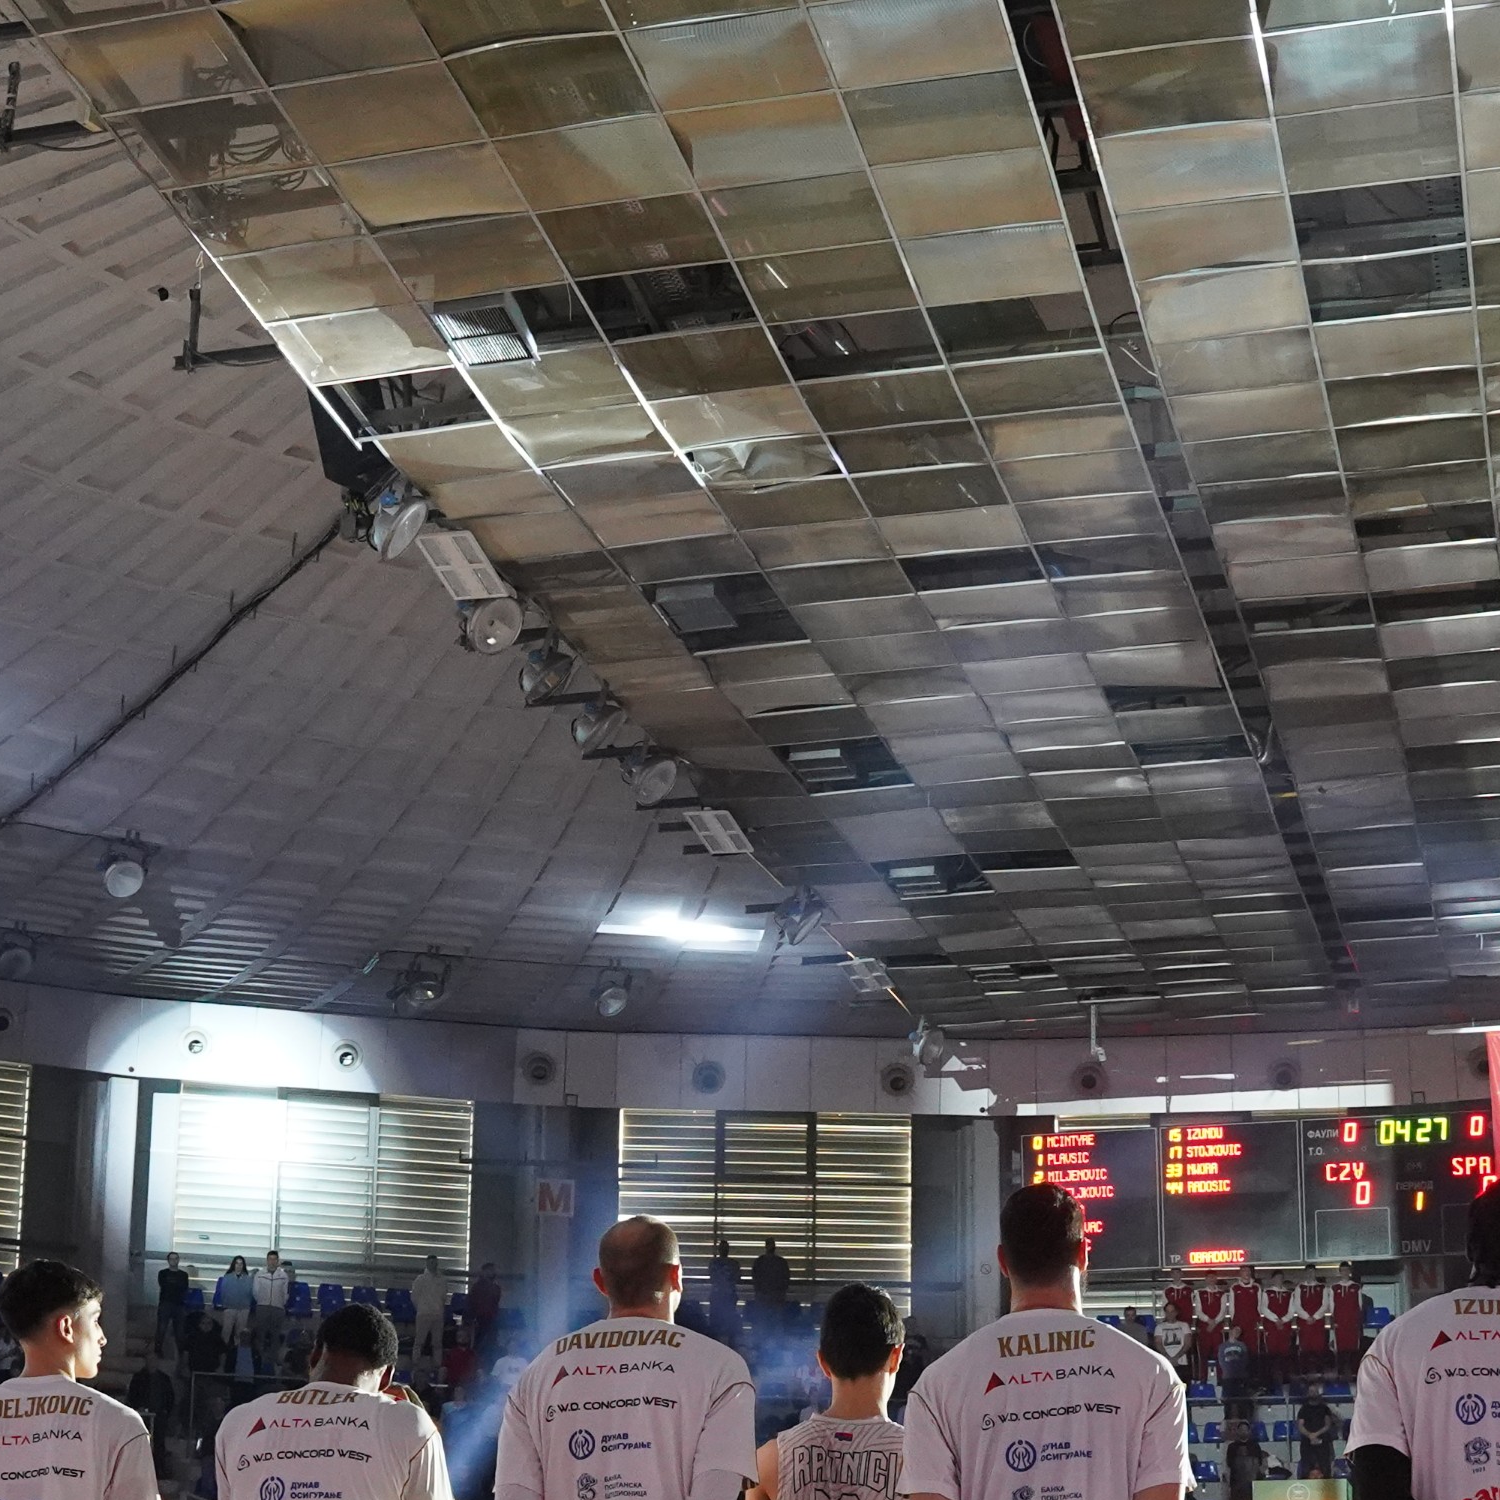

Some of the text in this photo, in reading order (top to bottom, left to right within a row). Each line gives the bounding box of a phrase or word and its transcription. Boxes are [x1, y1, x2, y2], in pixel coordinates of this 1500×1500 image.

[1344, 1123, 1357, 1142] 0
[1470, 1116, 1483, 1136] 0
[1186, 1144, 1241, 1157] STOJKOVIC
[1047, 1153, 1089, 1164] PLAVSIC
[1452, 1156, 1491, 1175] SPA
[1166, 1164, 1182, 1176] 33
[1326, 1162, 1364, 1181] CZV
[1166, 1180, 1231, 1194] 44 RADOSIC
[1356, 1182, 1370, 1204] 0
[539, 1182, 573, 1212] M
[1402, 1240, 1431, 1252] DMV
[1189, 1250, 1244, 1264] OBRADOVIC
[556, 1329, 685, 1355] DAVIDOVAC
[997, 1326, 1096, 1358] KALINIĆ
[1445, 1368, 1468, 1377] W.D.
[277, 1390, 358, 1405] BUTLER
[557, 1397, 677, 1413] W.D. CONCORD WEST
[998, 1403, 1121, 1423] W.D. CONCORD WEST
[253, 1449, 372, 1463] W.D. CONCORD WEST
[1, 1467, 49, 1481] CONCORD
[52, 1466, 86, 1479] WEST
[290, 1481, 319, 1490] ДУНАВ
